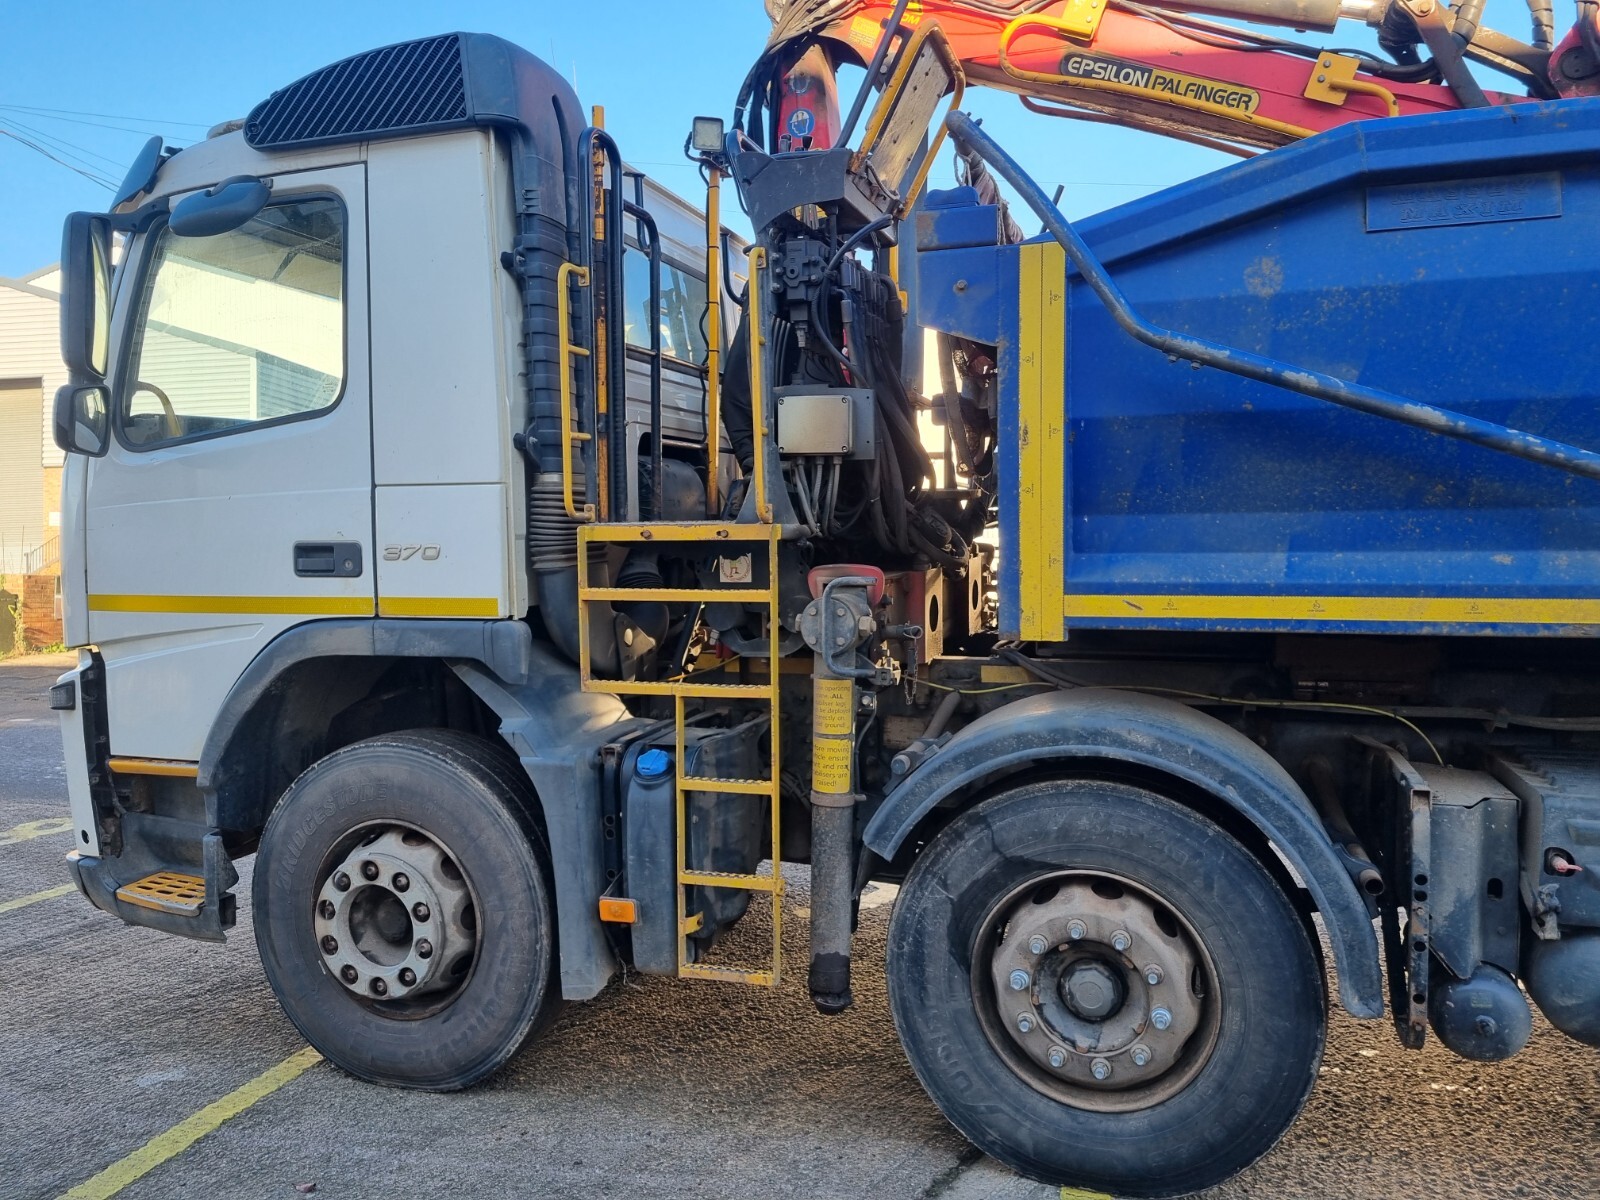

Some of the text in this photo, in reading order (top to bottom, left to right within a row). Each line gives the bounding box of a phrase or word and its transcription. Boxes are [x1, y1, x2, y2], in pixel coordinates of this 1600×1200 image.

[1067, 56, 1253, 111] EPSILON PALFINGER
[383, 544, 440, 561] 370
[275, 782, 388, 893] BRIDGESTONE
